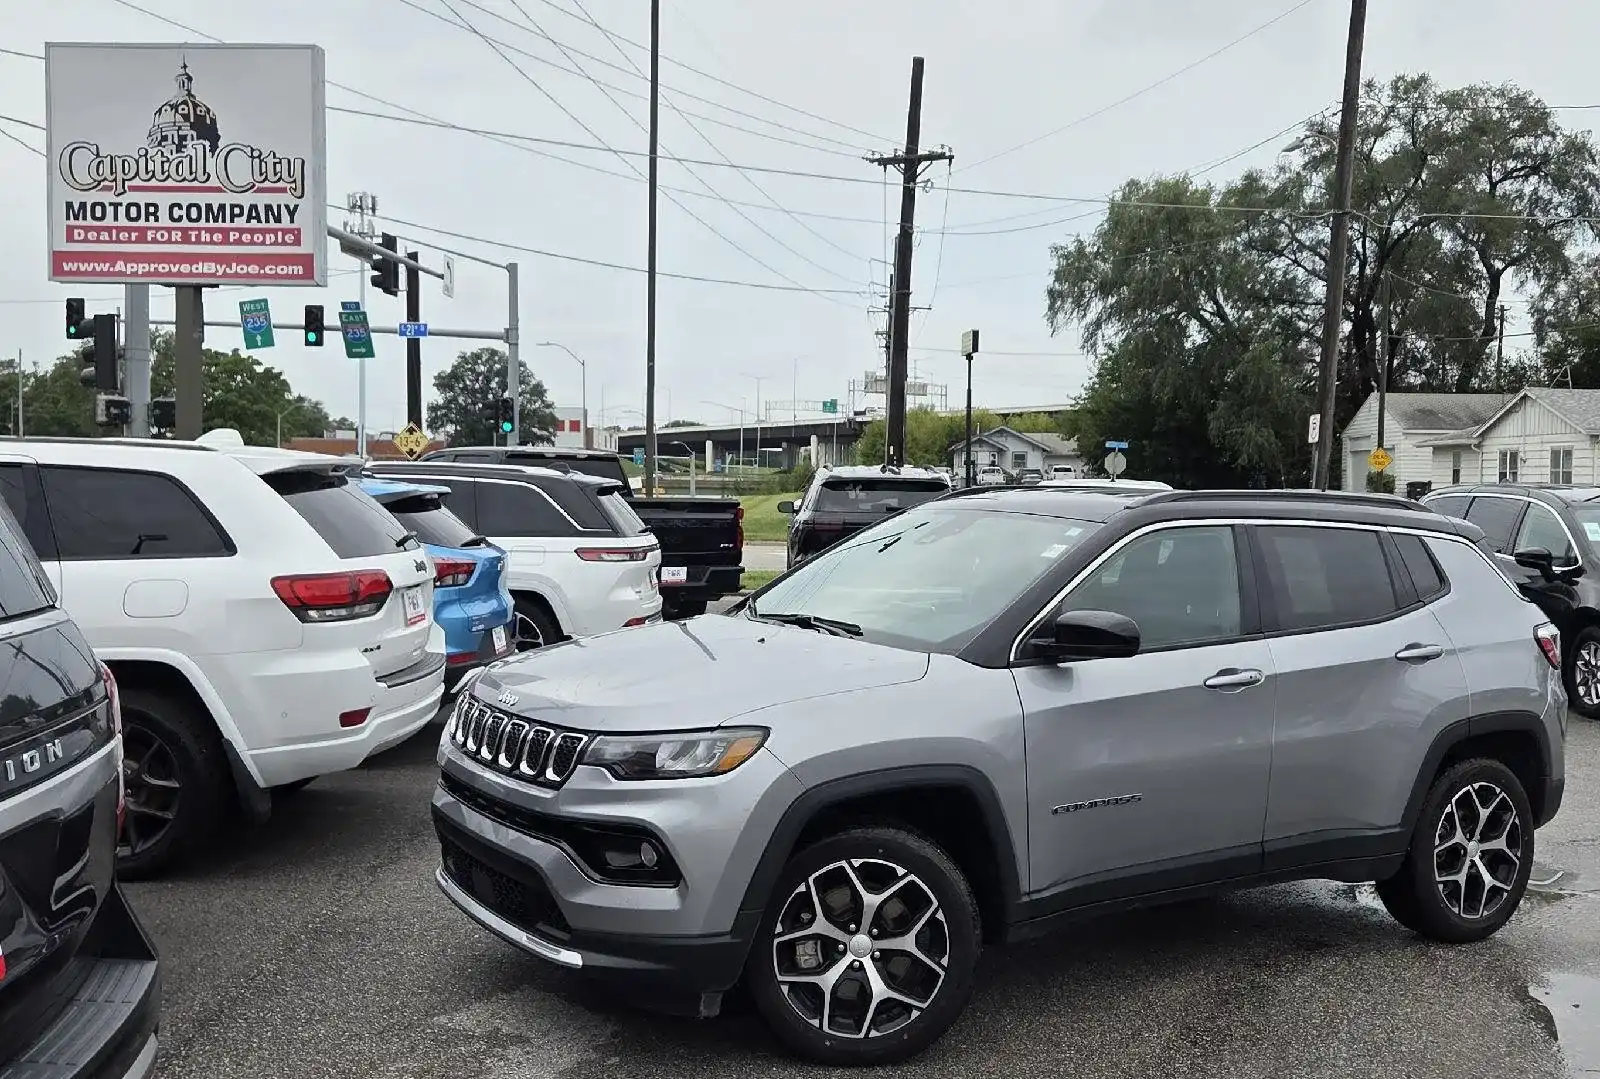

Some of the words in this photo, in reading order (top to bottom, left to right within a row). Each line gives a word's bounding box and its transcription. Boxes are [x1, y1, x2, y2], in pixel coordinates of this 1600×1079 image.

[59, 140, 211, 197] Capital
[215, 141, 305, 199] City
[65, 200, 160, 222] MOTOR
[168, 202, 300, 224] COMPANY
[73, 228, 139, 241] Dealer
[147, 229, 182, 242] FOR
[188, 230, 223, 243] The
[62, 259, 304, 276] www.ApprovedByJoe.com
[242, 302, 266, 311] WEST
[247, 316, 267, 328] 235
[342, 313, 365, 322] EAST
[347, 328, 367, 338] 235
[1051, 792, 1143, 816] COMPASS
